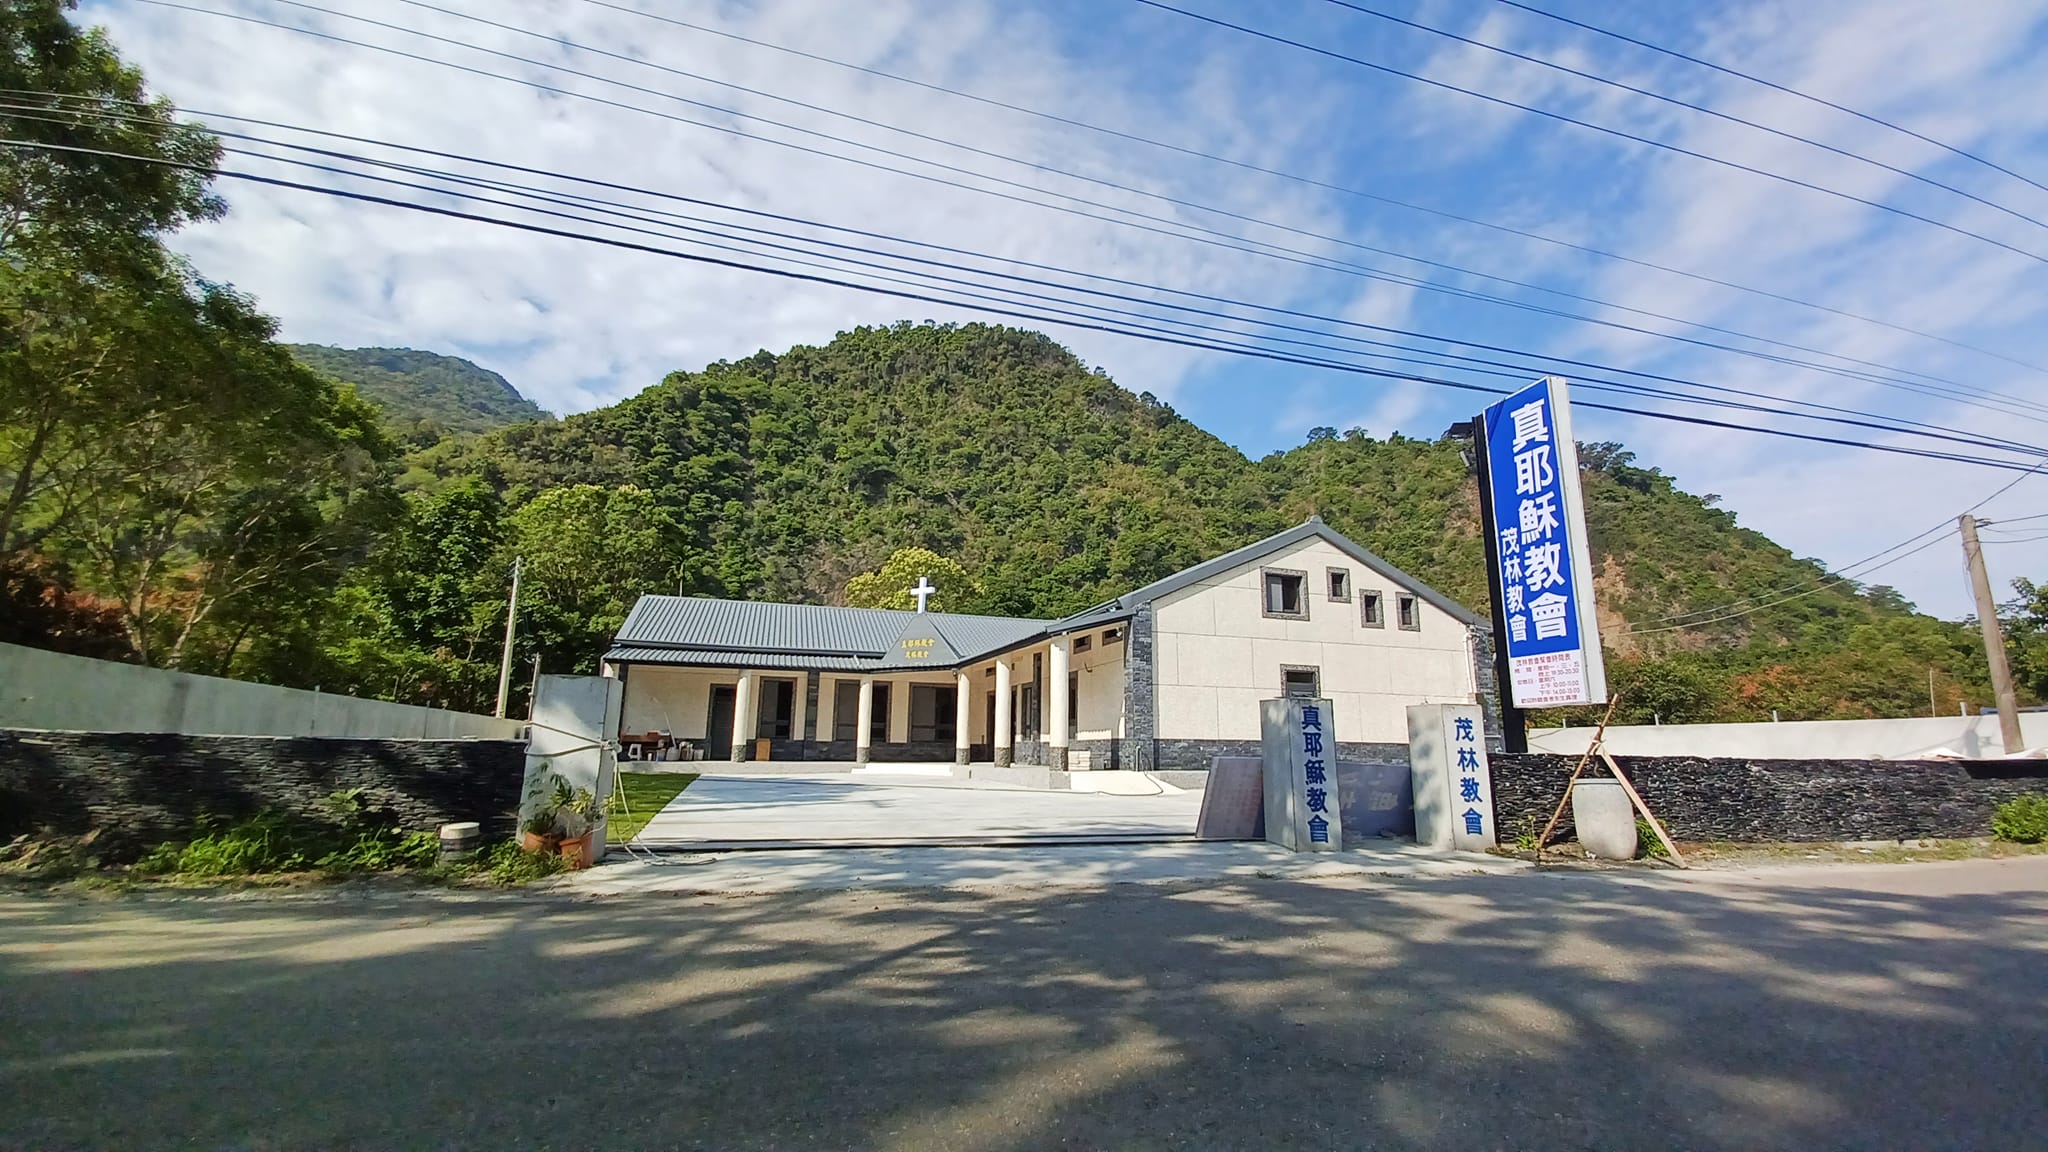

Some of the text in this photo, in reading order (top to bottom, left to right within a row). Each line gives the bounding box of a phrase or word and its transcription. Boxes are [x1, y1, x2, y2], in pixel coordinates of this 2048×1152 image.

[1510, 398, 1567, 640] 真耶穌教會
[1500, 526, 1527, 643] 茂林教會
[1301, 705, 1329, 844] 真耶穌教會
[1454, 717, 1484, 836] 茂林教會
